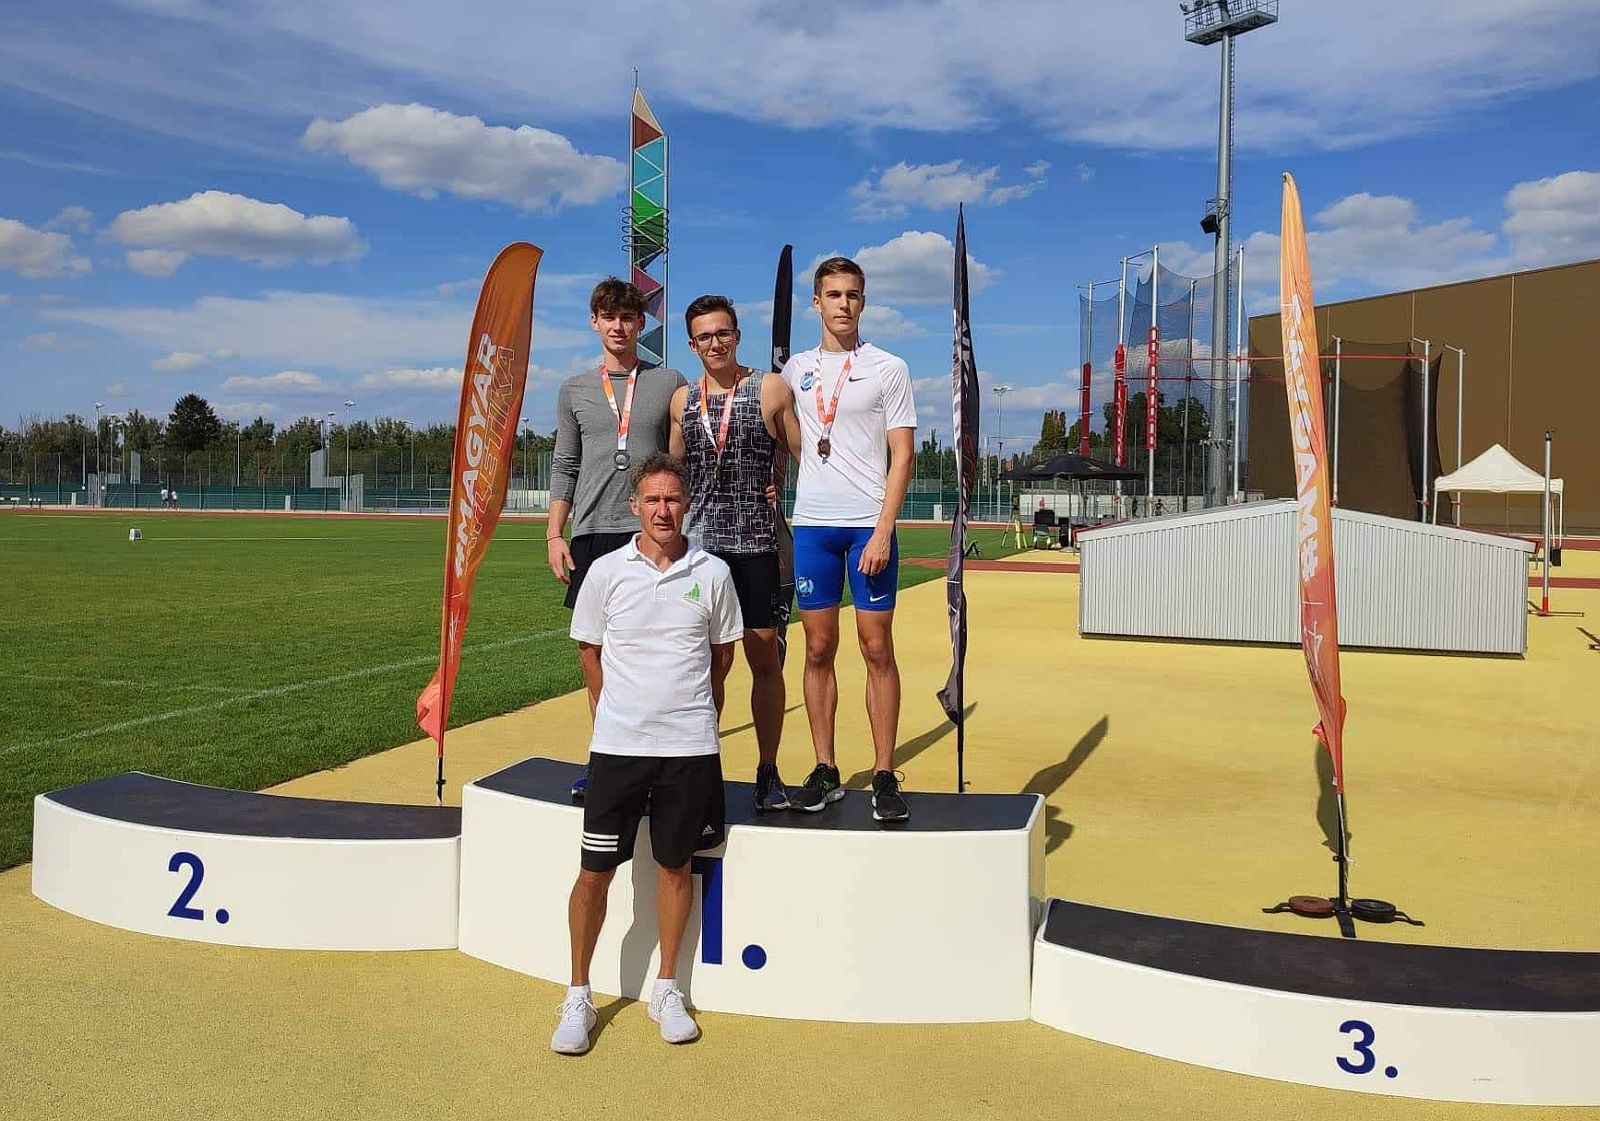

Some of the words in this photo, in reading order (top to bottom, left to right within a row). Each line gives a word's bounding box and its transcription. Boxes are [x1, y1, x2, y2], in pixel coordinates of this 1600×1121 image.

[454, 333, 497, 578] #MAGYAR
[167, 851, 230, 925] 2.
[690, 855, 768, 970] 1.
[1336, 1019, 1399, 1079] 3.
